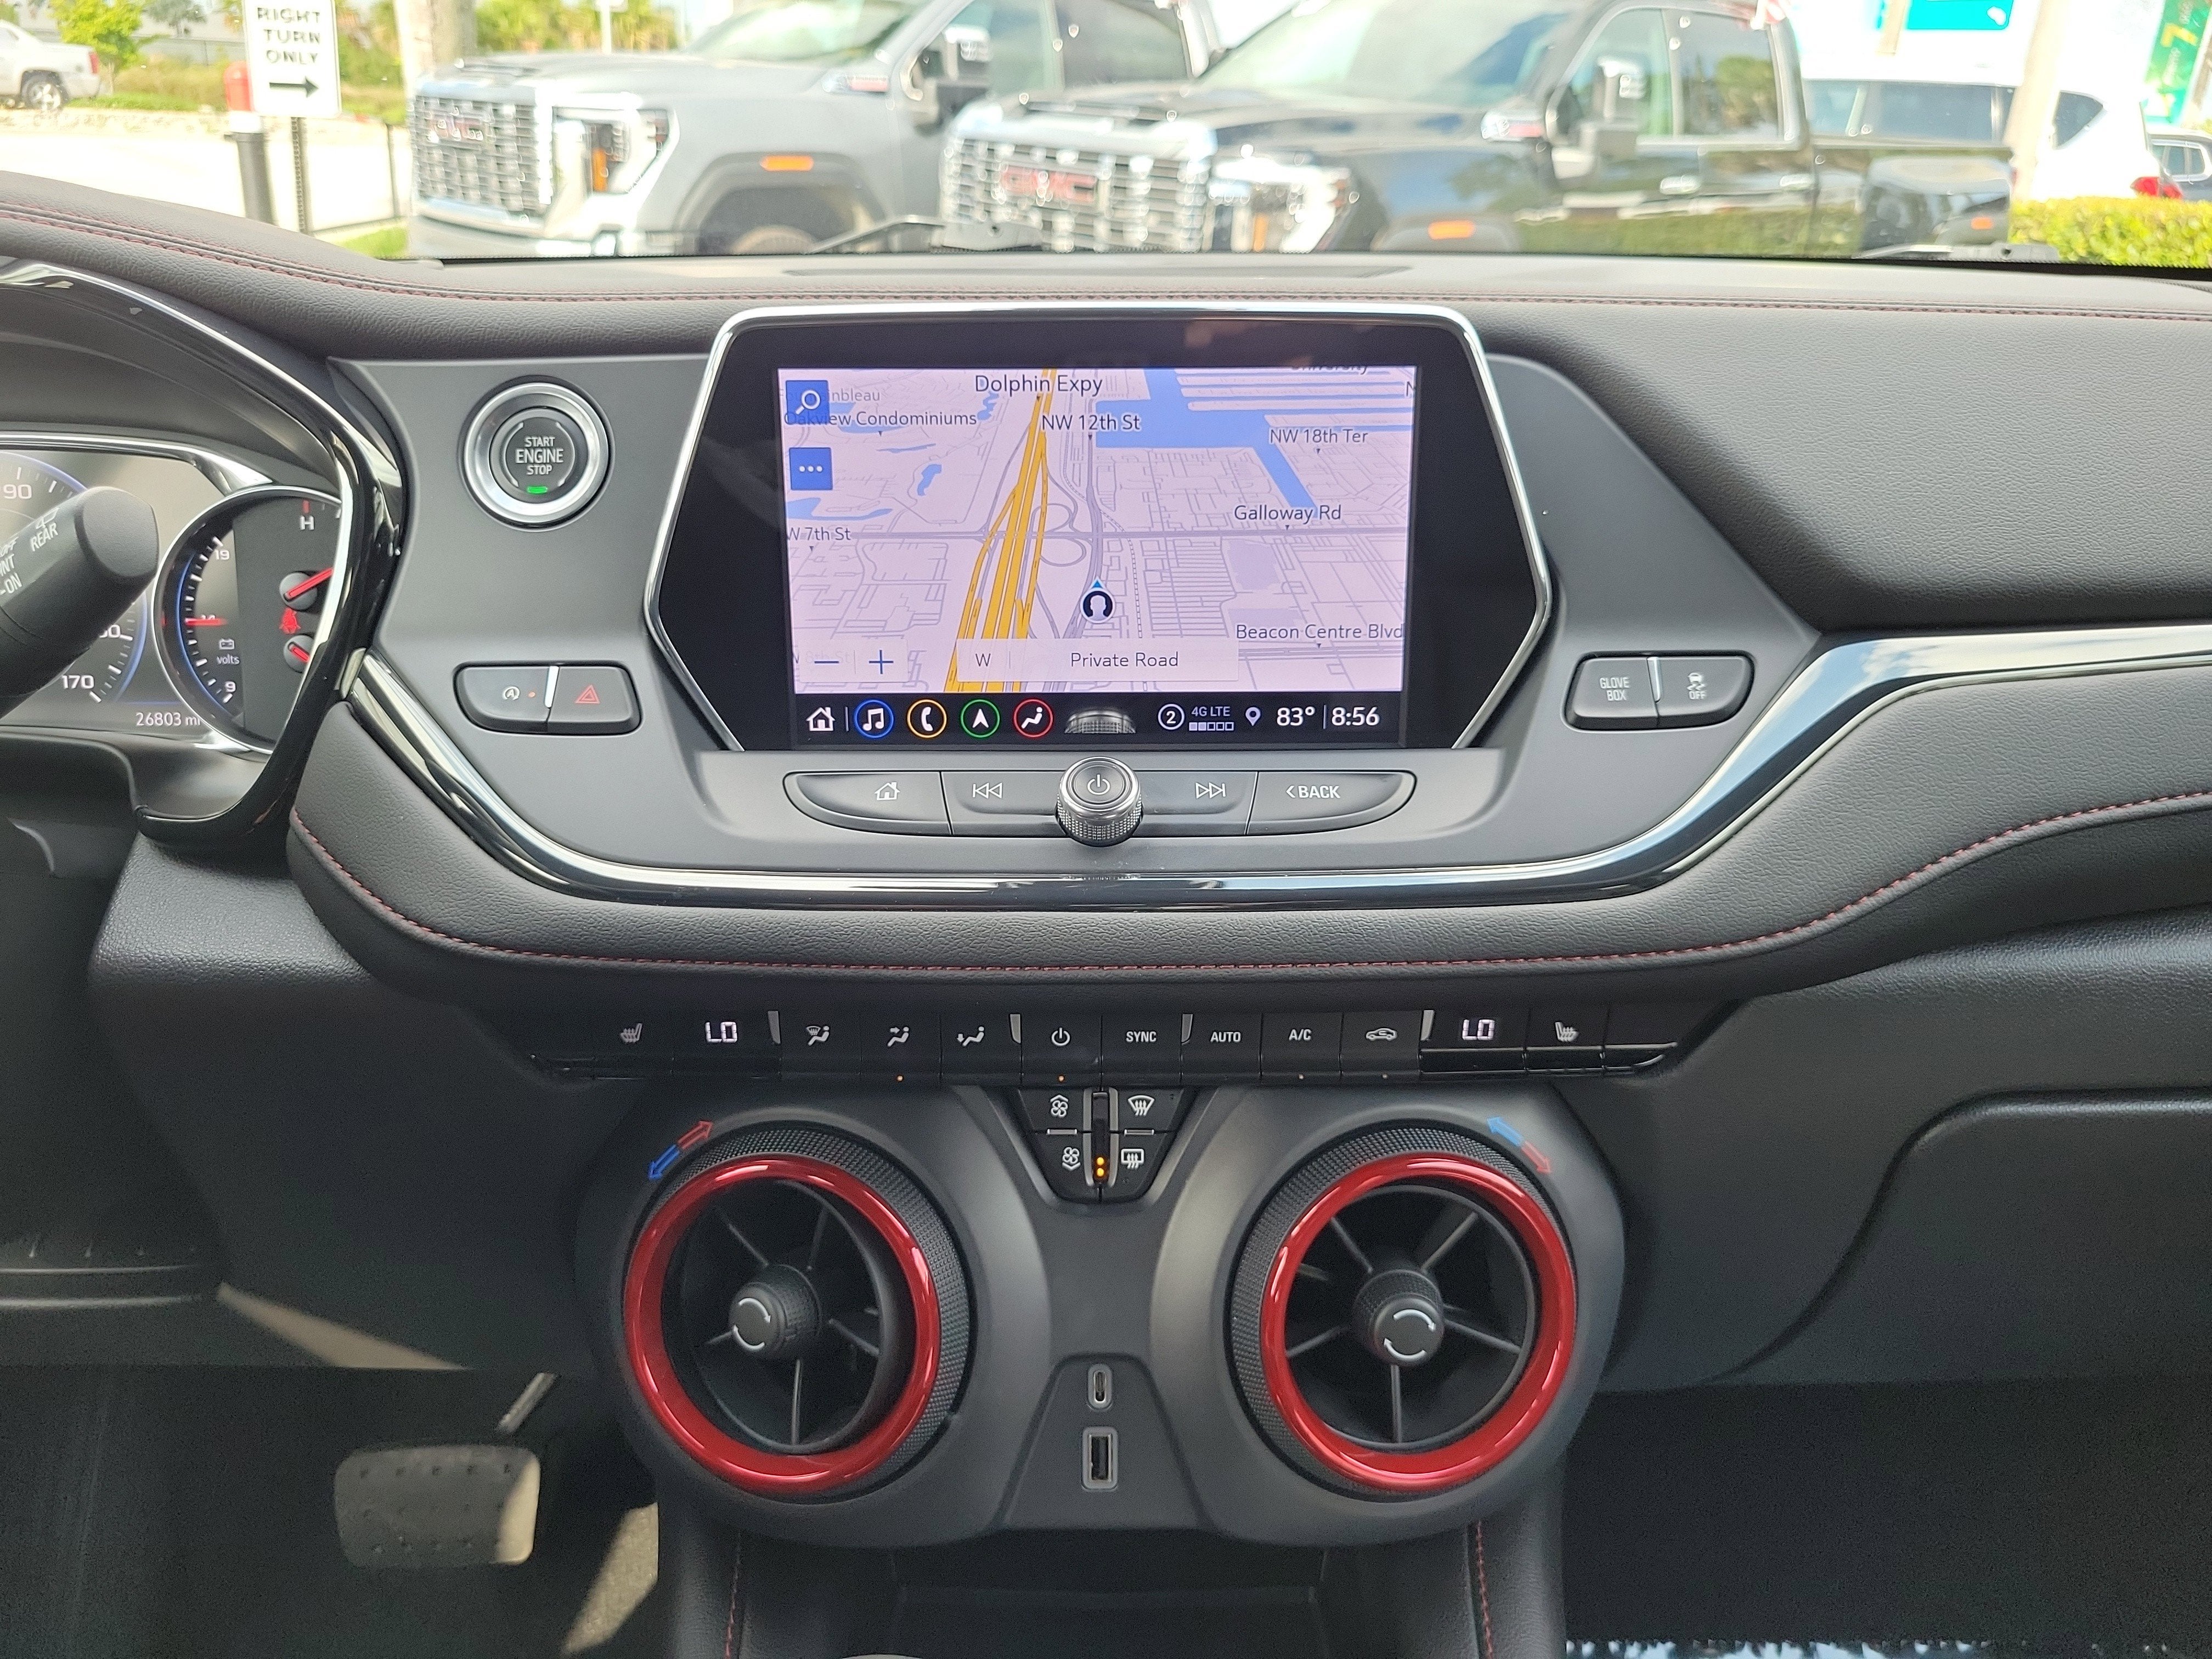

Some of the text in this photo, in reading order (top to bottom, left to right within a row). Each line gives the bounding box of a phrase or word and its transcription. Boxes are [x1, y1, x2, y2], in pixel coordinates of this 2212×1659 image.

[257, 7, 320, 23] RIGHT
[263, 29, 320, 44] TURN
[266, 50, 318, 64] ONLY
[975, 374, 1103, 397] Dolphin Expy
[856, 410, 977, 425] Condominiums
[1042, 414, 1140, 430] NW 12th St
[524, 436, 556, 447] START
[1269, 429, 1368, 443] NW 18th Ter
[516, 448, 564, 464] ENGINE
[527, 464, 552, 475] STOP
[3, 484, 32, 499] 90
[1234, 505, 1341, 525] Galloway Rd
[300, 515, 314, 531] H
[30, 522, 59, 552] REAR
[804, 527, 830, 541] 7th
[835, 527, 851, 541] St
[215, 550, 230, 561] 19
[4, 572, 22, 594] ON
[1236, 623, 1403, 639] Beacon Centre Blvd
[217, 653, 240, 665] volts
[975, 651, 1179, 667] W Private Road
[61, 674, 94, 689] 170
[225, 681, 236, 693] 9
[1599, 677, 1630, 689] GLOVE
[1607, 690, 1627, 702] BOX
[1689, 691, 1707, 700] OFF
[1166, 711, 1177, 724] 2
[1191, 706, 1231, 717] 4G LTE
[1276, 706, 1316, 726] 83°
[1331, 706, 1380, 726] 8:56
[136, 712, 201, 726] 26803 mi
[1297, 785, 1341, 799] BACK
[1126, 1031, 1157, 1043] SYNC
[1210, 1031, 1242, 1043] AUTO
[1288, 1028, 1312, 1041] A/C
